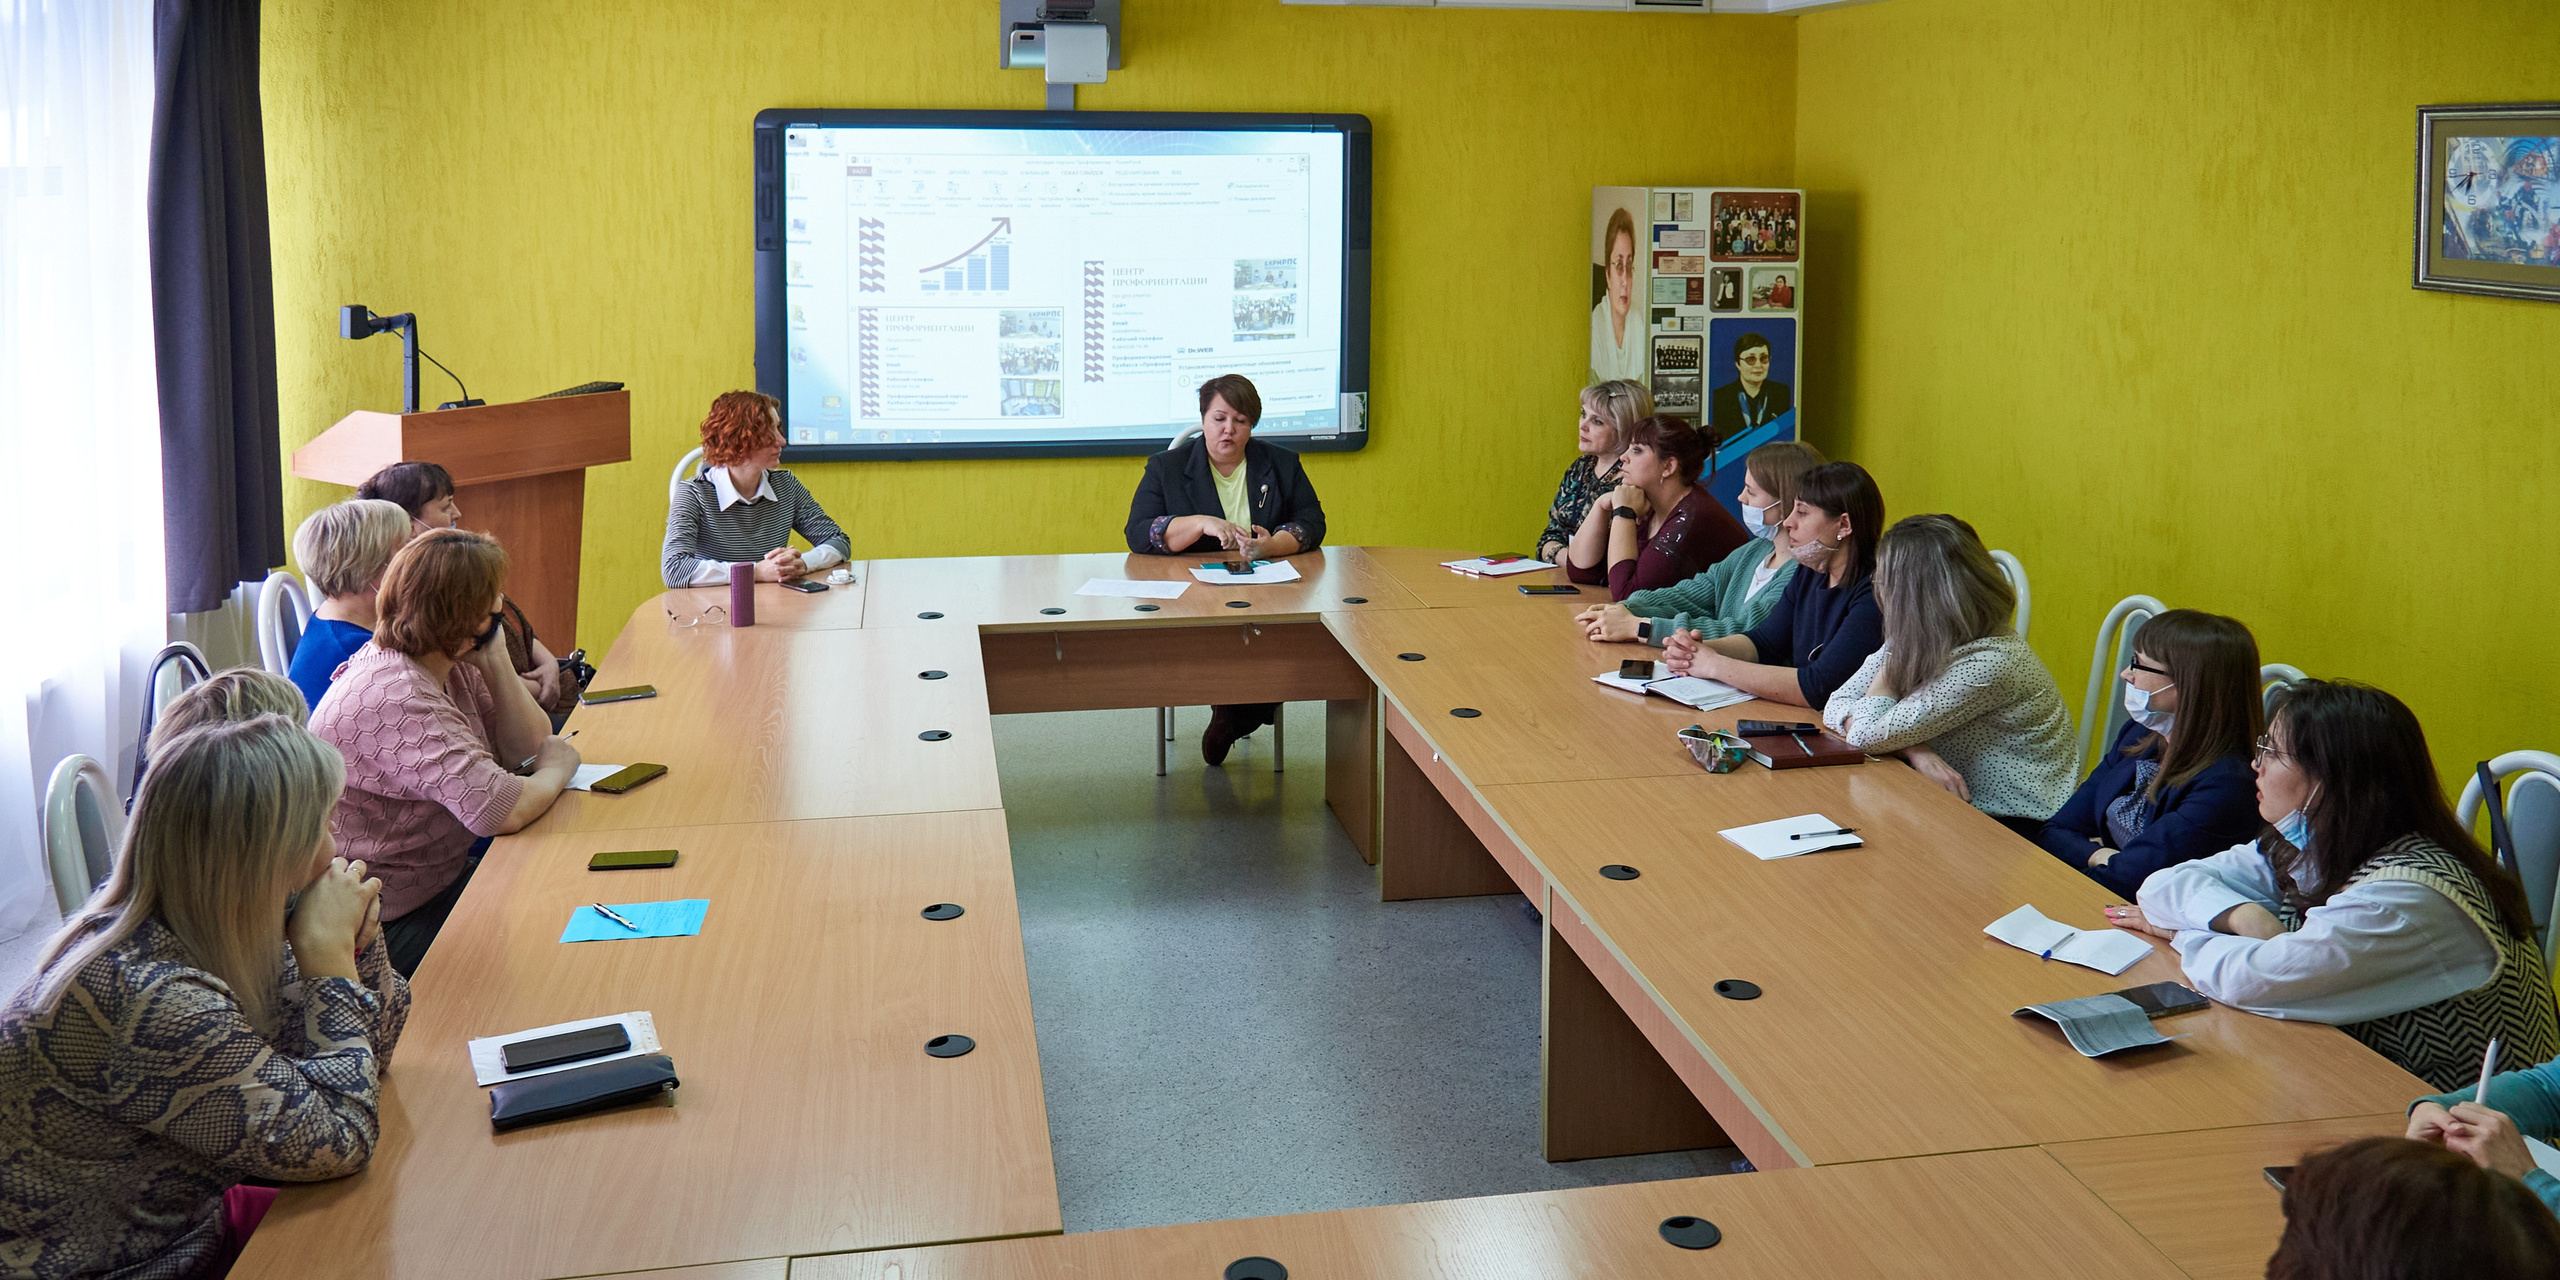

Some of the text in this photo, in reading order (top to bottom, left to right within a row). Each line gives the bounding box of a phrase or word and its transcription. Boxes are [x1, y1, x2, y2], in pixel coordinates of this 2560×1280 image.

[2464, 143, 2481, 155] 12
[2467, 194, 2477, 206] 6
[1112, 267, 1145, 276] ЦЕНТР
[1112, 277, 1208, 287] ПРОФОРИЕНТАЦИИ
[885, 324, 975, 332] ПРОФОРИЕНТАЦИИ
